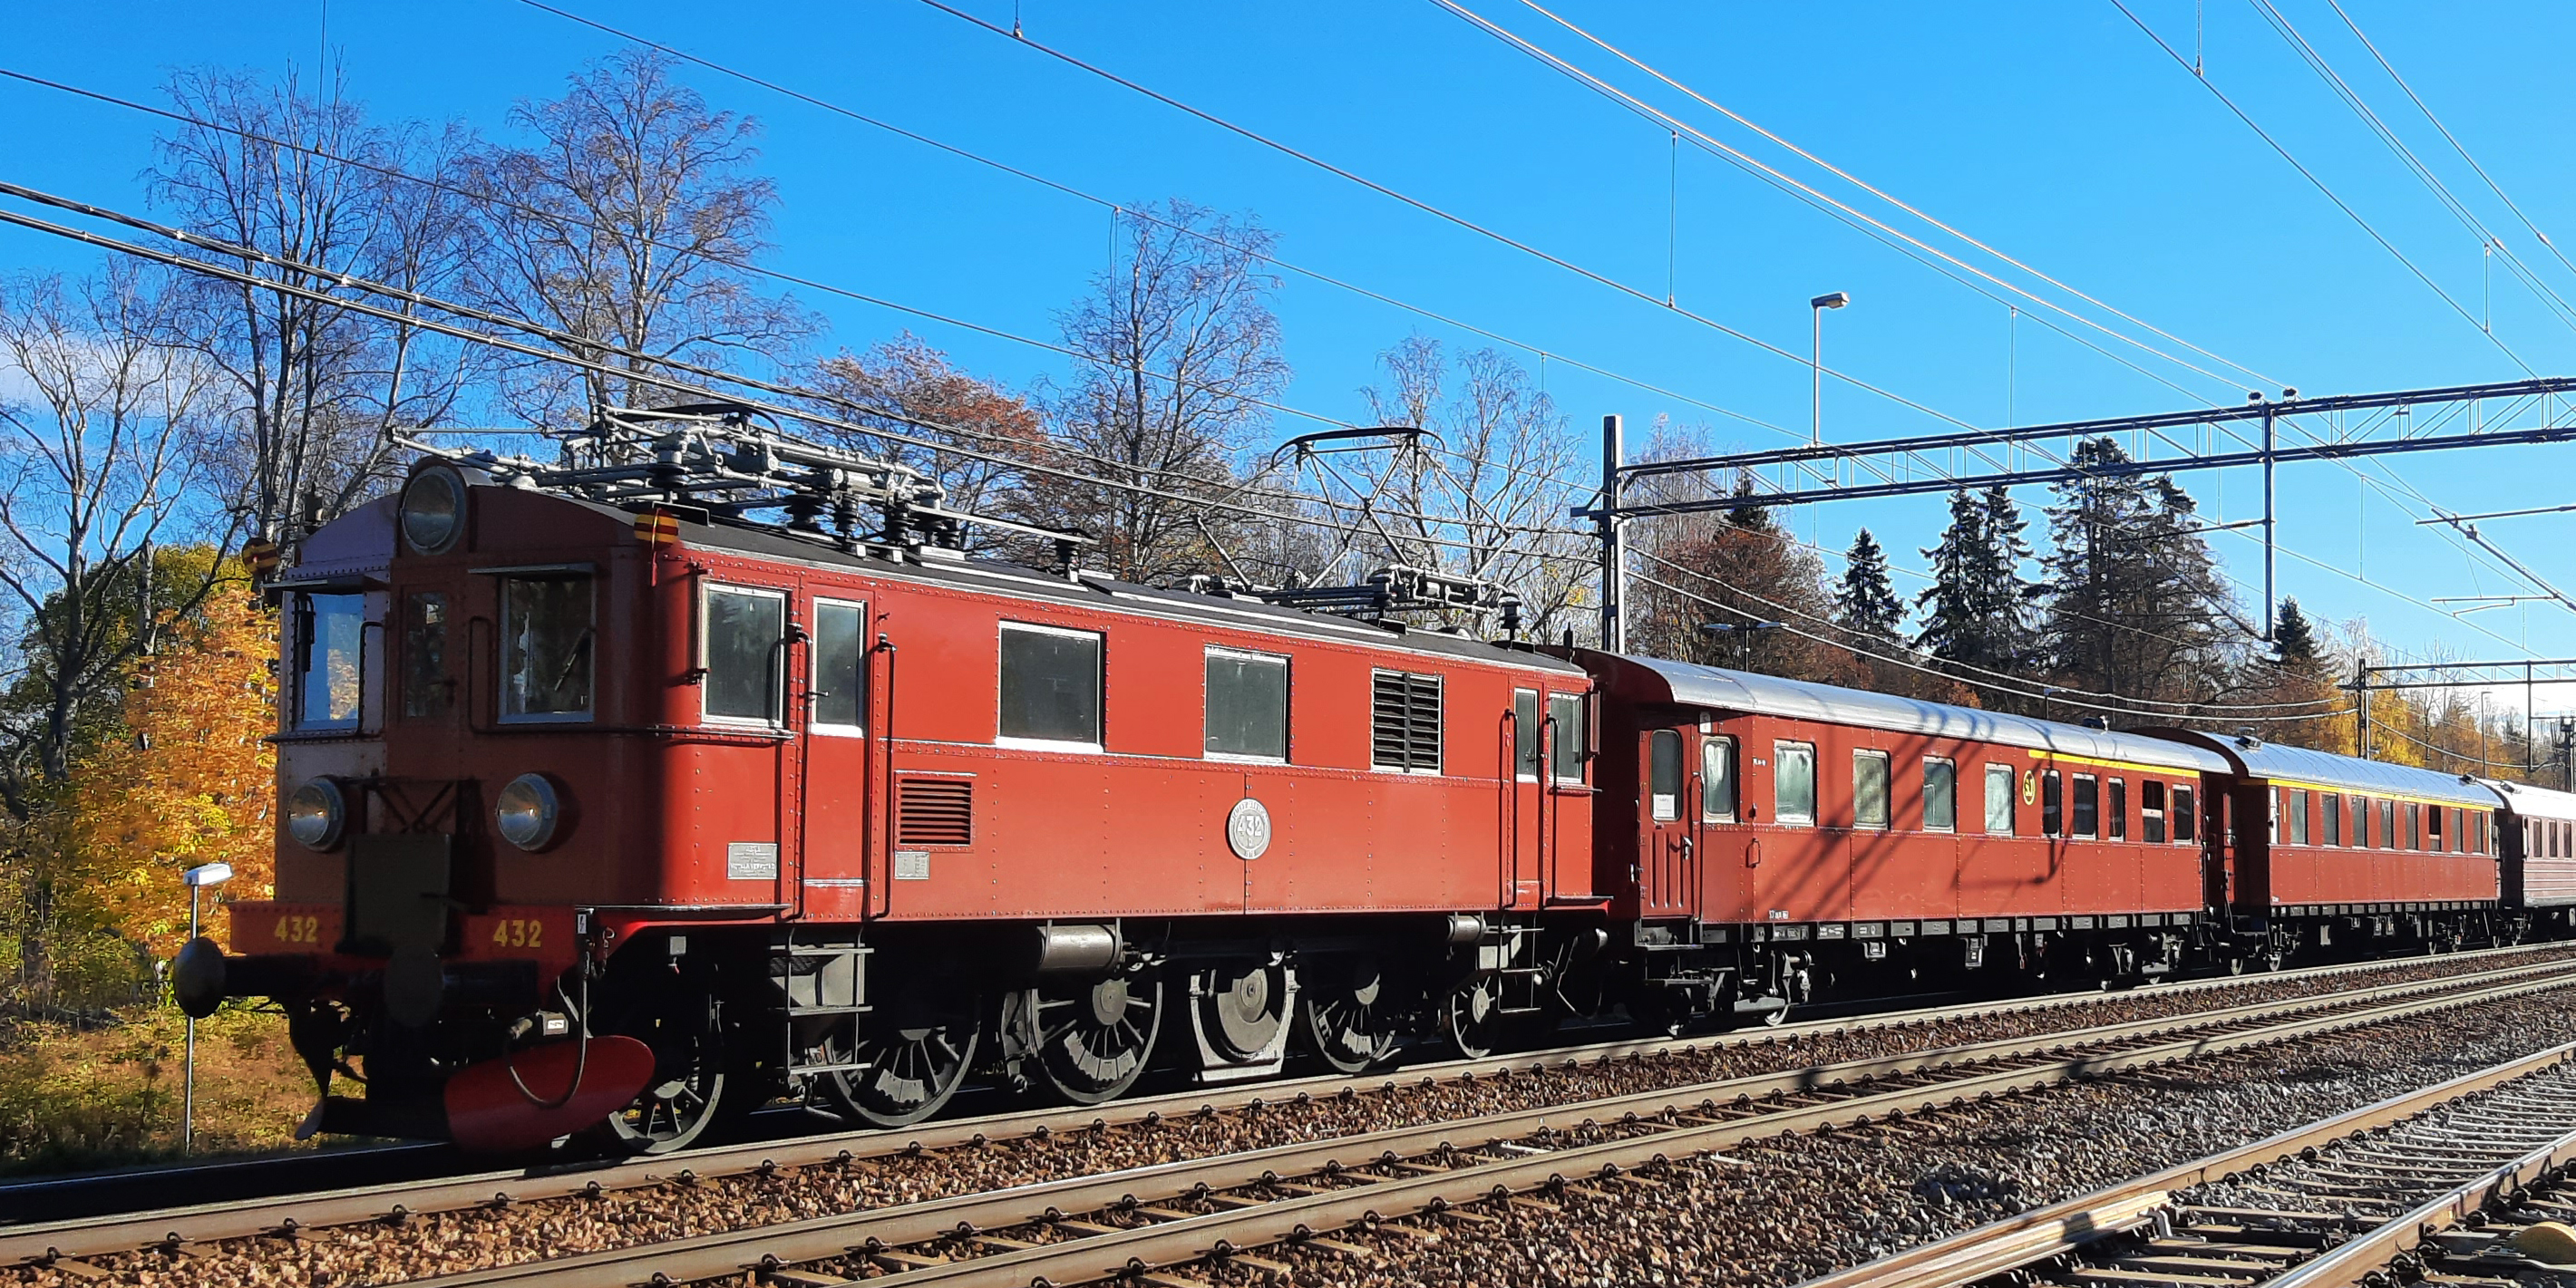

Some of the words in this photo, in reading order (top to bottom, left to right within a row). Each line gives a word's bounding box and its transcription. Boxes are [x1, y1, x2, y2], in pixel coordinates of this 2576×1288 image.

[1236, 815, 1263, 837] 432
[274, 915, 317, 942] 432
[492, 919, 541, 948] 432
